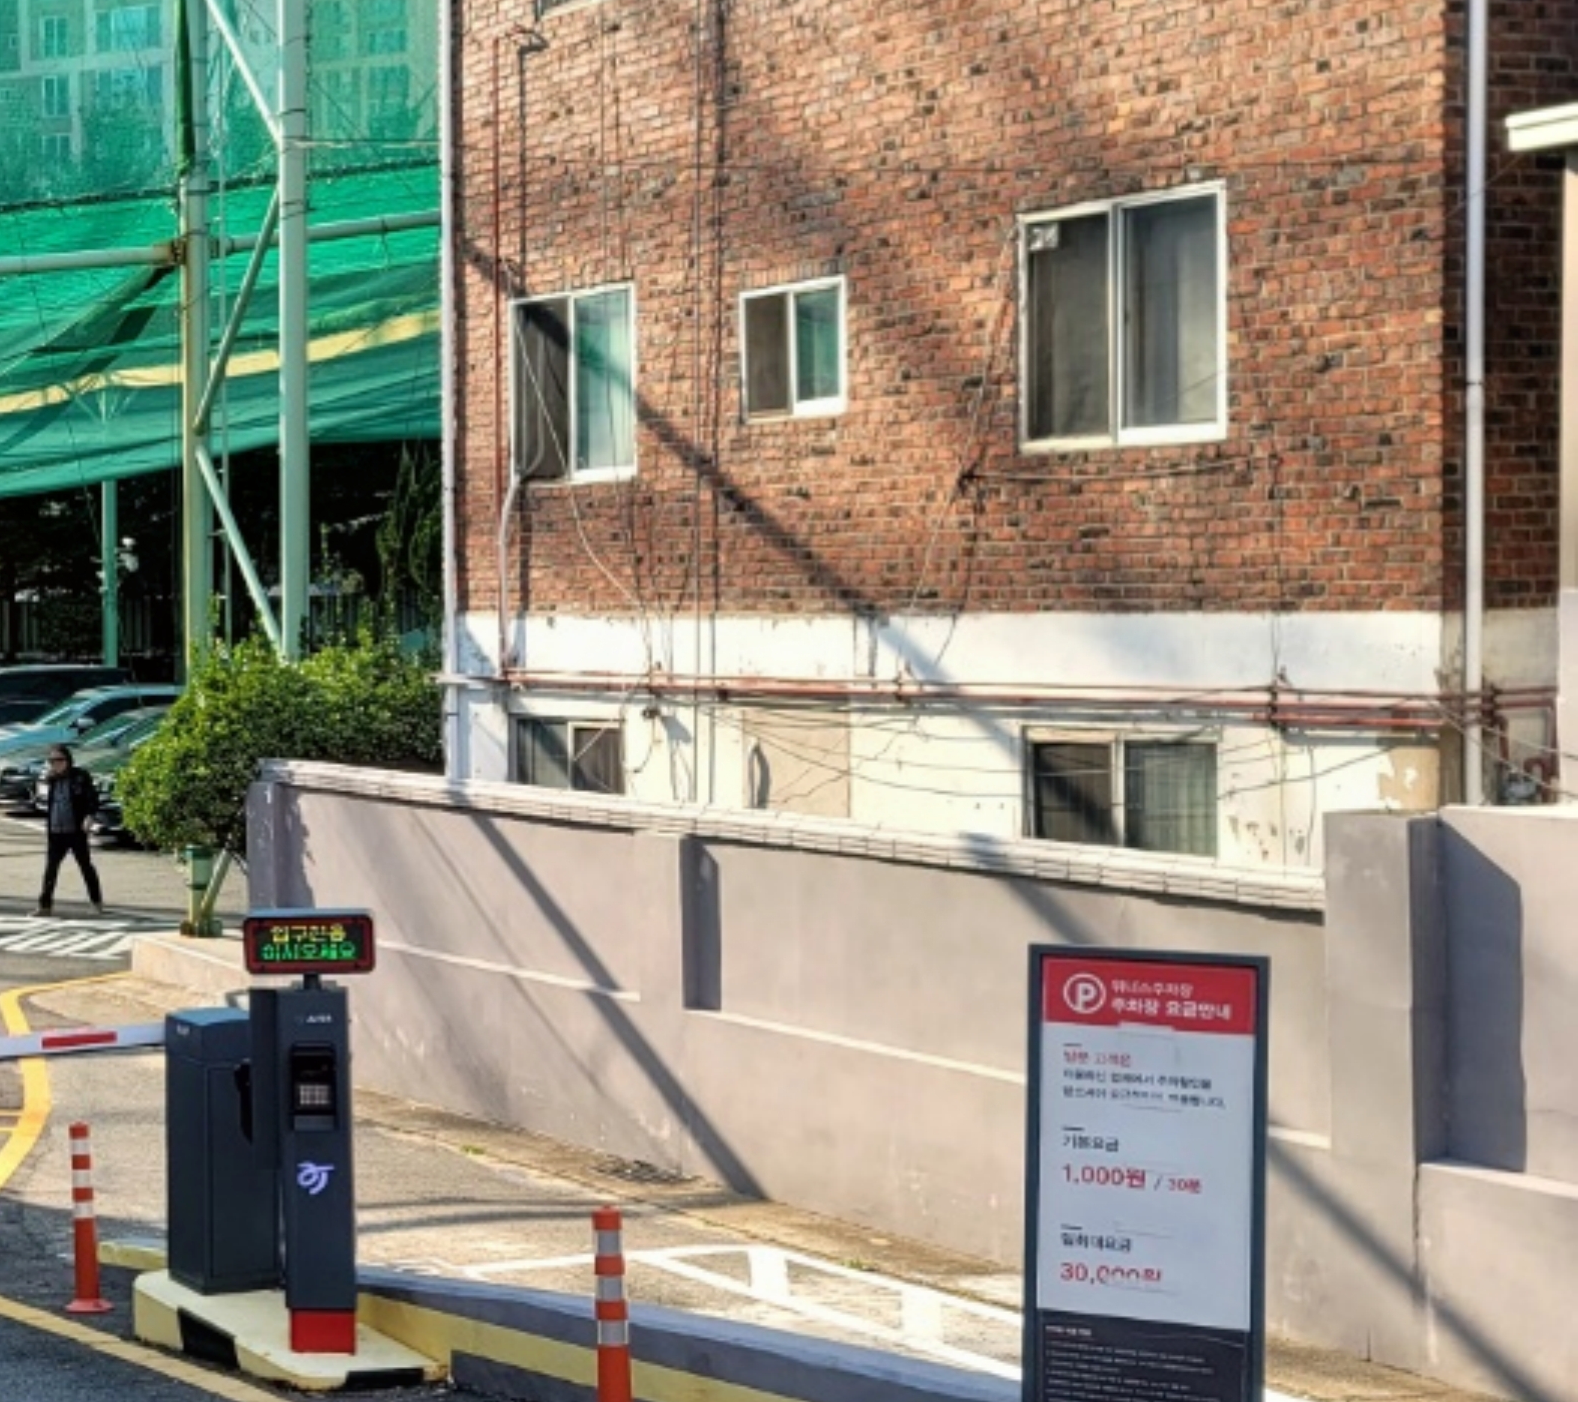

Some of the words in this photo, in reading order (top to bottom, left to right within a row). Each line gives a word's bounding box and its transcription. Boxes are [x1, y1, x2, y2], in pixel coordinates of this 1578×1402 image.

[1111, 997, 1159, 1017] 주차장
[1165, 1001, 1232, 1021] 요금안내
[1063, 1134, 1120, 1153] 기본요금
